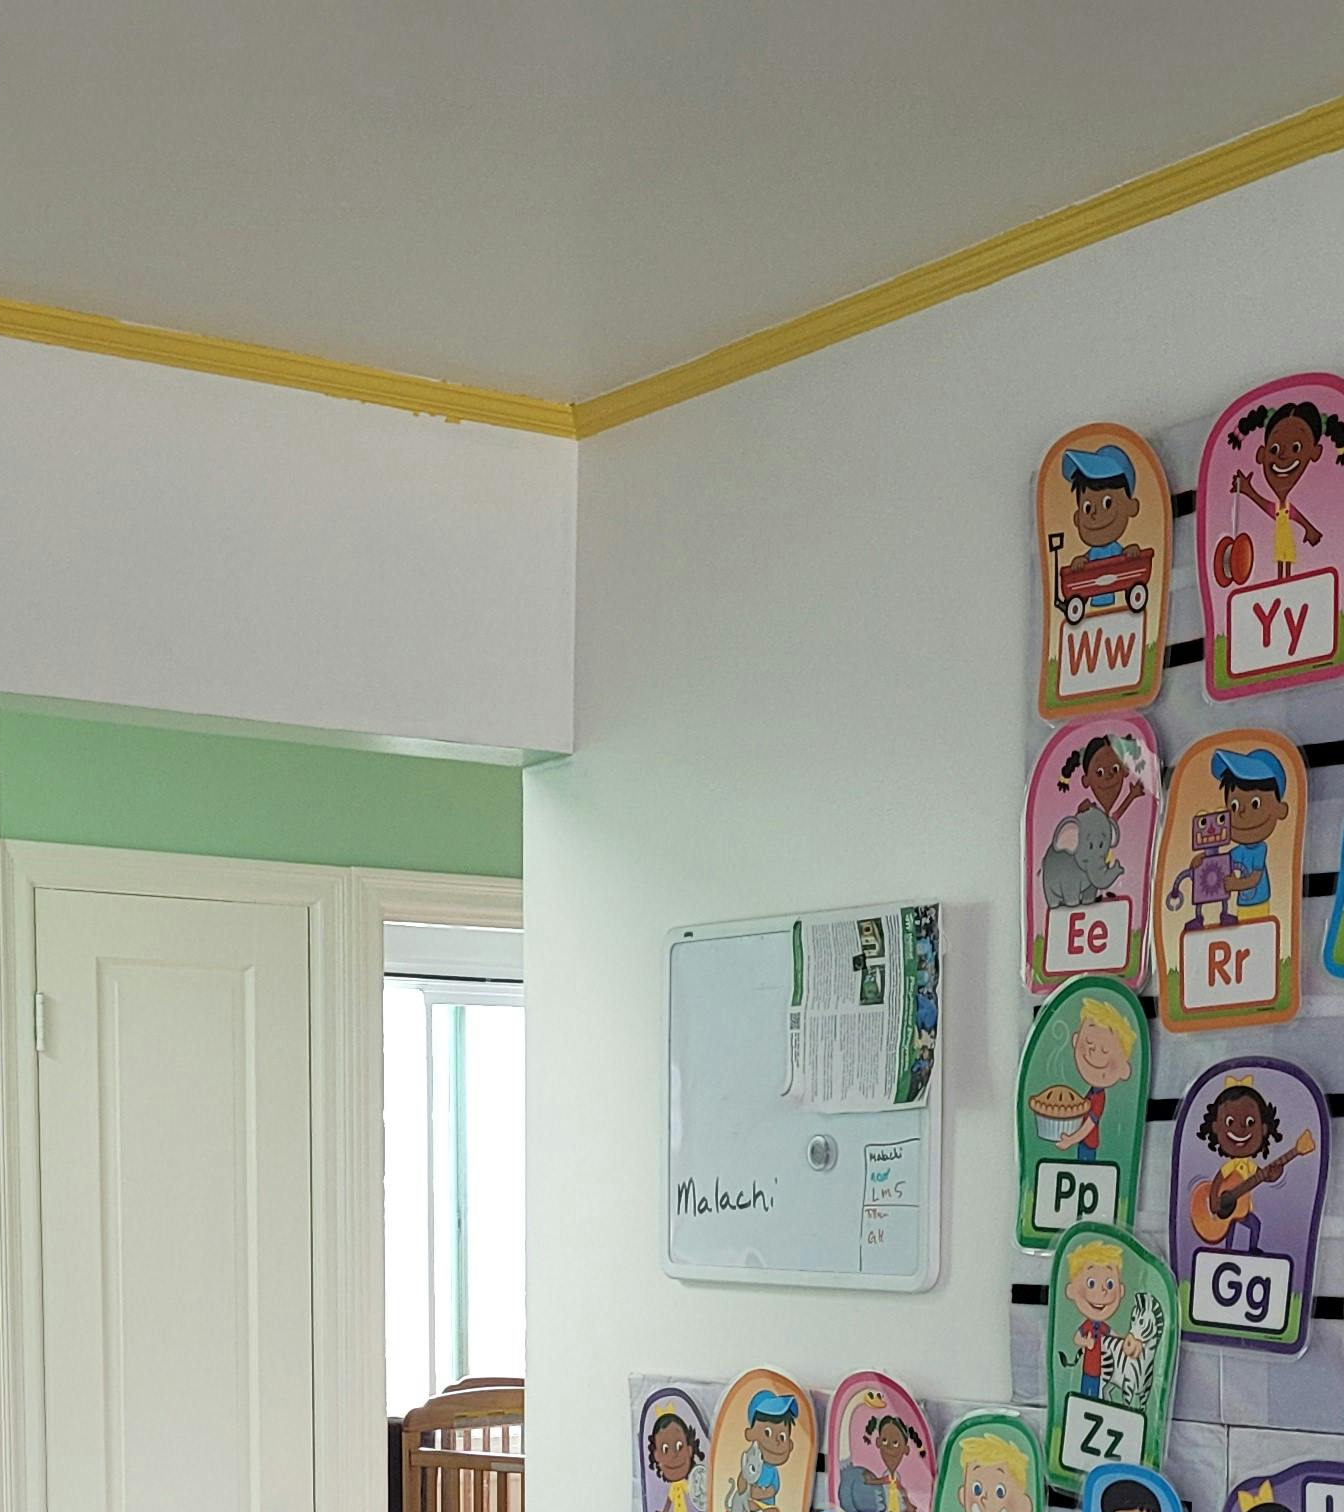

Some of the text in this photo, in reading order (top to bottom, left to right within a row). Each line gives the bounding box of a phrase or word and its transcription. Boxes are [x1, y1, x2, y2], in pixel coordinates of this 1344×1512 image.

[1067, 627, 1136, 677] Ww
[1252, 597, 1309, 657] Yy
[1067, 911, 1109, 955] Ee
[1208, 940, 1251, 988] Rr
[677, 1177, 778, 1217] Malachi
[1054, 1170, 1099, 1221] Pp
[1211, 1261, 1272, 1323] Gg
[1080, 1411, 1124, 1462] Zz
